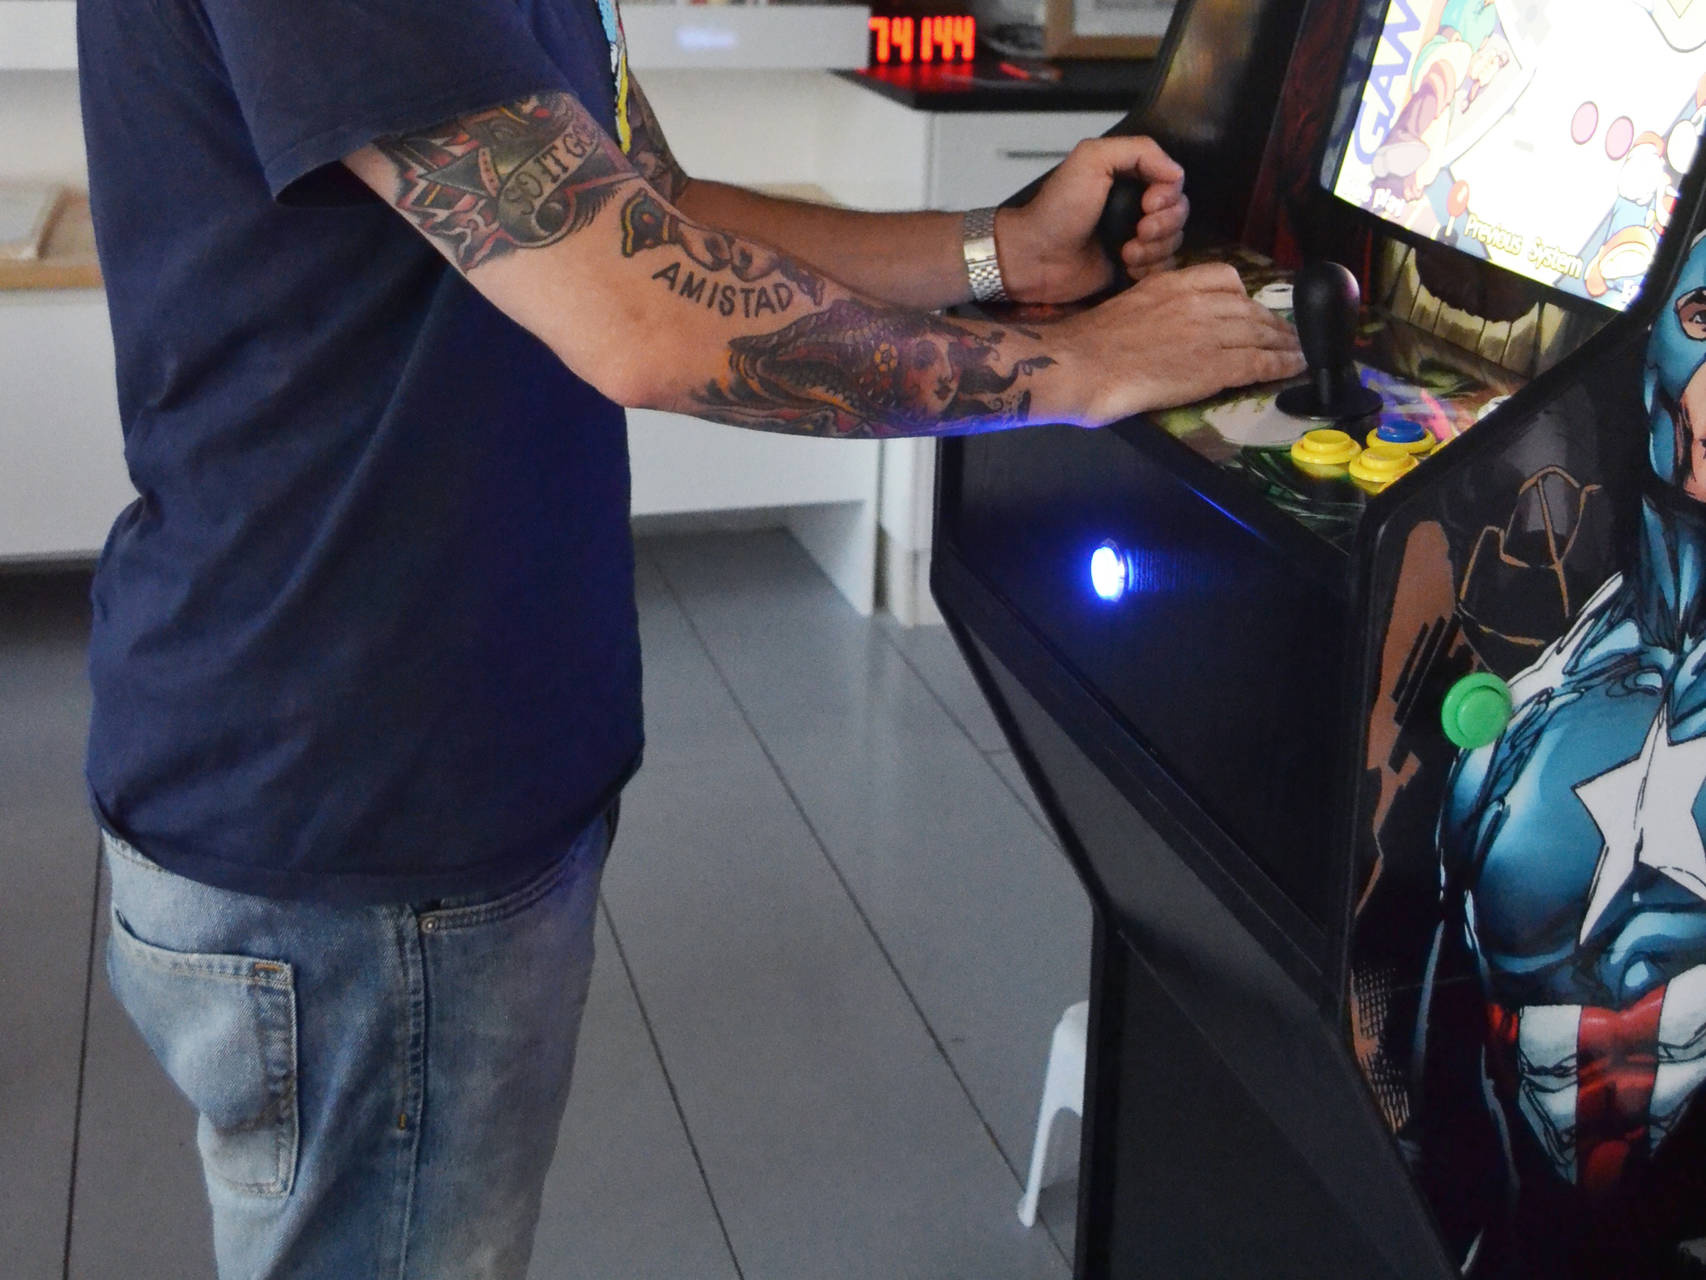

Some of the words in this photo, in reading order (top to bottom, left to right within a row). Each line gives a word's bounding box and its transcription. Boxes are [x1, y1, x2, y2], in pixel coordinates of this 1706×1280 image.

[503, 171, 543, 216] SO
[534, 143, 569, 183] IT
[1464, 211, 1524, 256] Previous
[1528, 235, 1585, 280] System
[652, 260, 794, 319] AMISTAD
